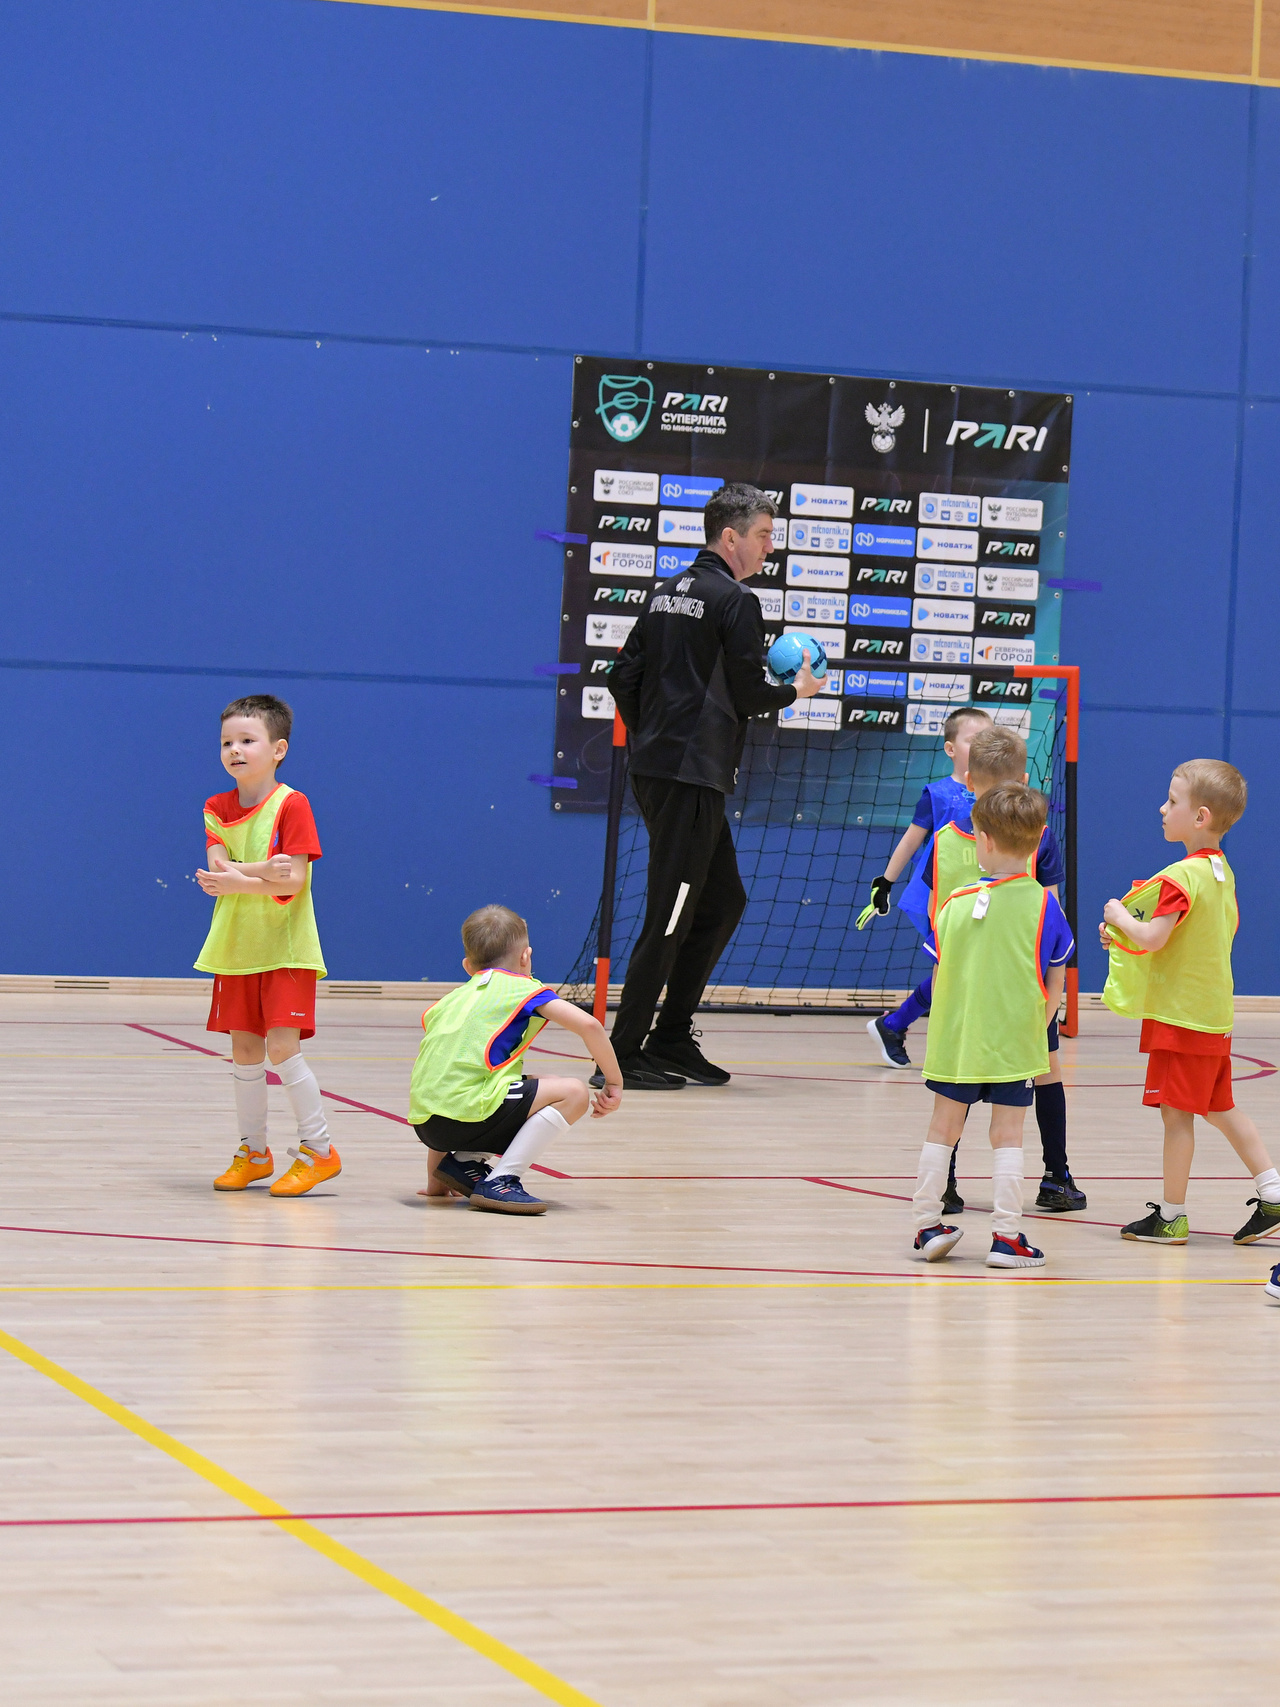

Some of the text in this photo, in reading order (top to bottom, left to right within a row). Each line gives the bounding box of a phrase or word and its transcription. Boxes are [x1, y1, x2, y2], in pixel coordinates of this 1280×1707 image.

[662, 392, 729, 413] PARI
[661, 413, 727, 428] СУПЕРЛИГА
[661, 424, 726, 435] ПО МИНИ-ФУТБОЛУ
[946, 420, 1048, 452] PARI
[811, 497, 848, 506] НОВАТЭК
[860, 496, 912, 514] PARI
[941, 498, 978, 509] mfcnornik.ru
[598, 515, 651, 532] PARI
[679, 524, 705, 532] НОВА
[811, 524, 849, 536] mfcnornik.ru
[937, 542, 973, 550] НОВАТЭК
[985, 541, 1036, 557] PARI
[612, 551, 652, 560] СЕВЕРНЫЙ
[612, 558, 651, 569] ГОРОД
[807, 568, 844, 577] НОВАТЭК
[856, 568, 908, 584] PARI
[937, 568, 974, 580] mfcnornik.ru
[594, 587, 647, 604] PARI
[807, 597, 845, 608] mfcnornik.ru
[933, 612, 969, 620] НОВАТЭК
[981, 611, 1031, 627] PARI
[852, 638, 904, 655] PARI
[934, 640, 970, 650] mfcnornik.ru
[994, 646, 1033, 654] СЕВЕРНЫЙ
[994, 653, 1032, 663] ГОРОД
[929, 682, 965, 690] НОВАТЭК
[977, 681, 1028, 697] PARI
[799, 710, 836, 719] НОВАТЭК
[848, 709, 900, 725] PARI
